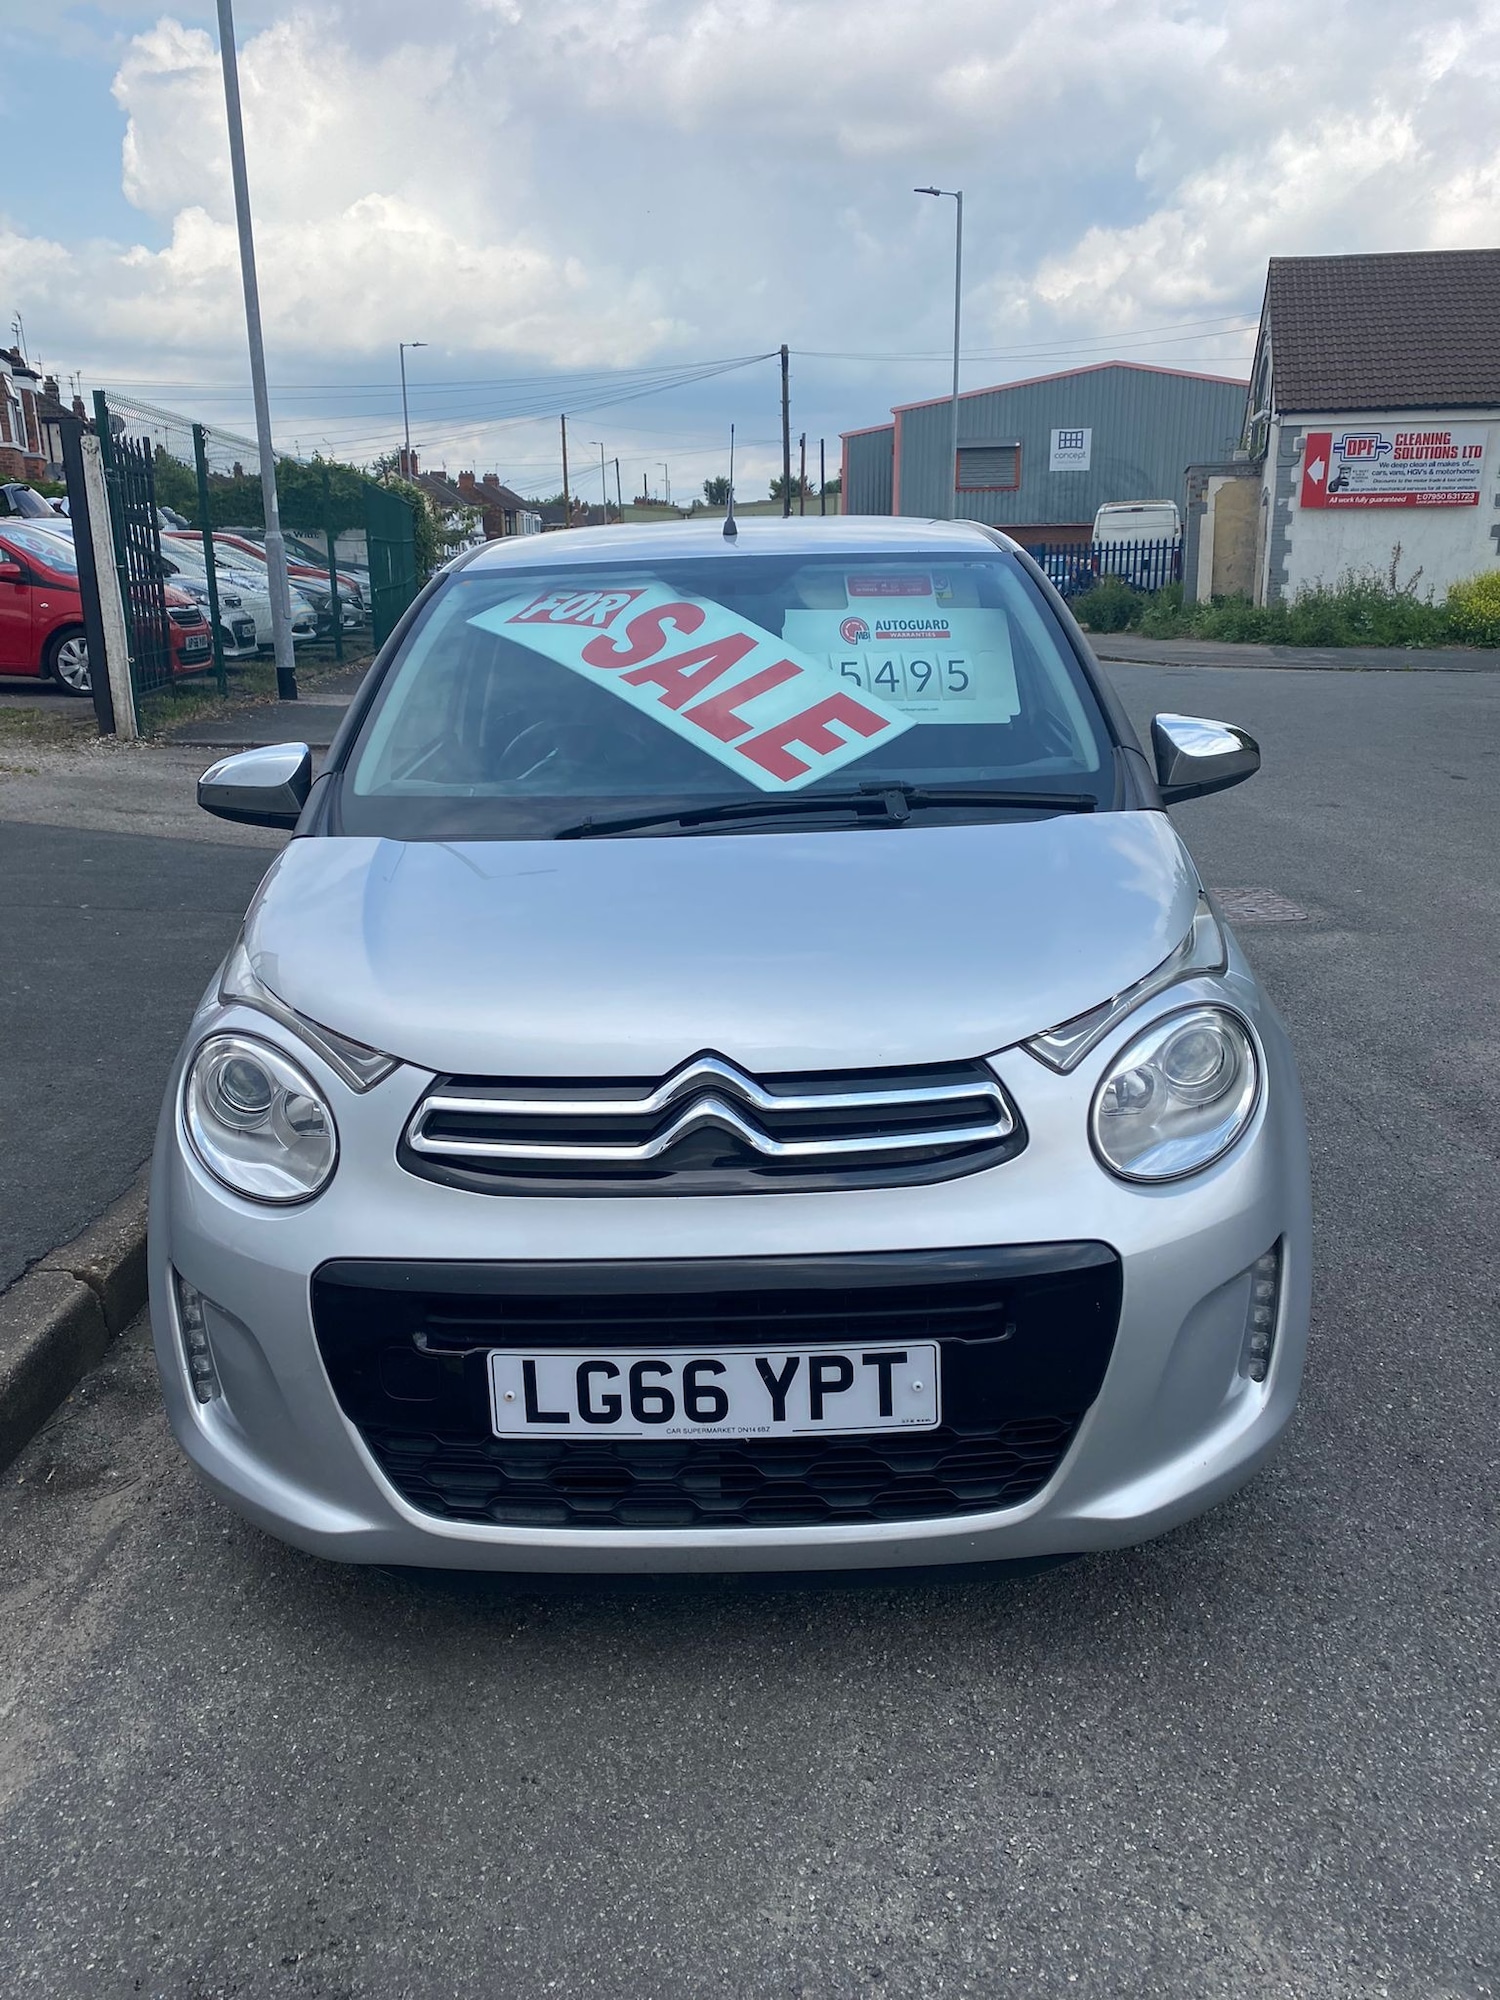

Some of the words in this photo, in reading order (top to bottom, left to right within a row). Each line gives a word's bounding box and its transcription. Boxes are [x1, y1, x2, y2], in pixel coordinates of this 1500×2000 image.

[1395, 432, 1452, 446] CLEANING
[1347, 439, 1375, 456] DPF
[1393, 446, 1459, 460] SOLUTIONS
[1462, 445, 1483, 459] LTD
[1055, 451, 1086, 460] concept
[1391, 461, 1409, 469] deep
[1428, 460, 1436, 468] all
[1435, 467, 1480, 475] motorhomes
[1355, 496, 1369, 504] fully
[1369, 495, 1407, 504] guaranteed
[518, 589, 631, 626] FOR
[875, 619, 949, 631] AUTOGUARD
[840, 659, 969, 693] 5495
[581, 602, 892, 783] SALE
[522, 1358, 730, 1424] LG66
[754, 1351, 908, 1422] YPT
[682, 1426, 736, 1435] SUPERMARKET
[737, 1426, 756, 1434] DN14
